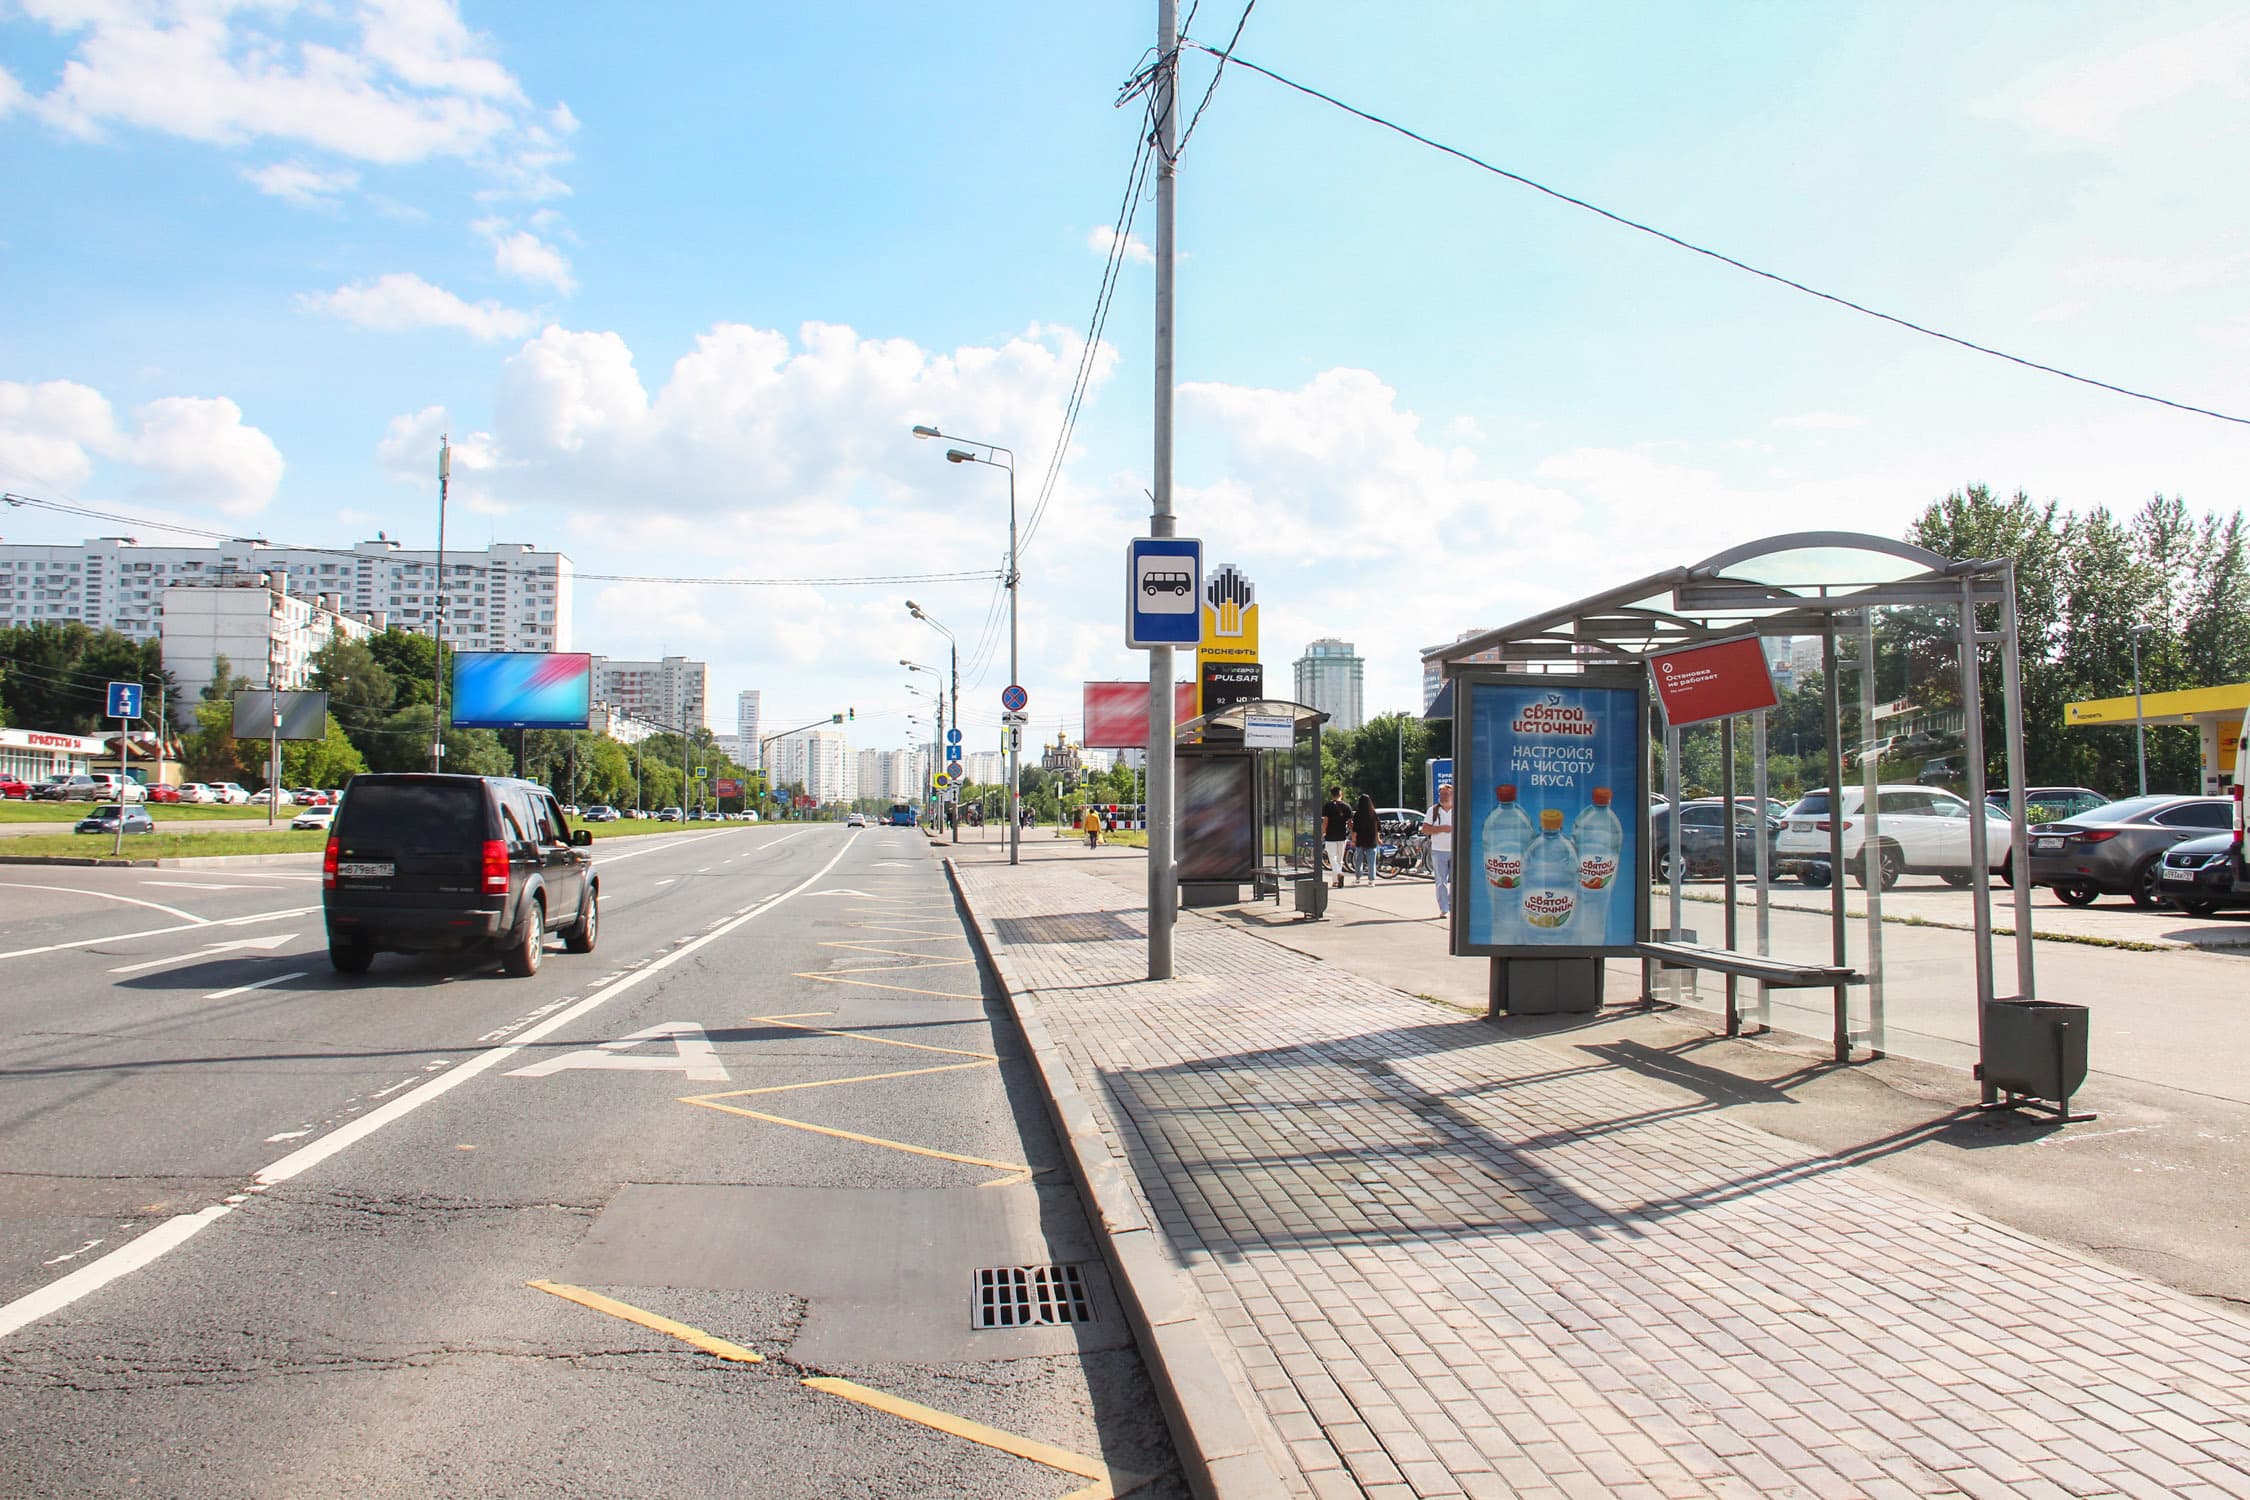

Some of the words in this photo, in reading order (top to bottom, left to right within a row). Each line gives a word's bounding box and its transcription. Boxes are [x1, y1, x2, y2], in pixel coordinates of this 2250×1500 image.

[1200, 647, 1256, 656] РОСНЕФТЬ
[1214, 674, 1259, 682] PULSAR
[1665, 668, 1711, 681] Остановка
[1680, 673, 1719, 687] работает
[1512, 744, 1593, 760] НАСТРОЙСЯ
[1511, 759, 1530, 772] НА
[1533, 760, 1595, 774] ЧИСТОТУ
[1530, 774, 1575, 787] ВКУСА
[1485, 863, 1521, 876] ИСТОЧНИ
